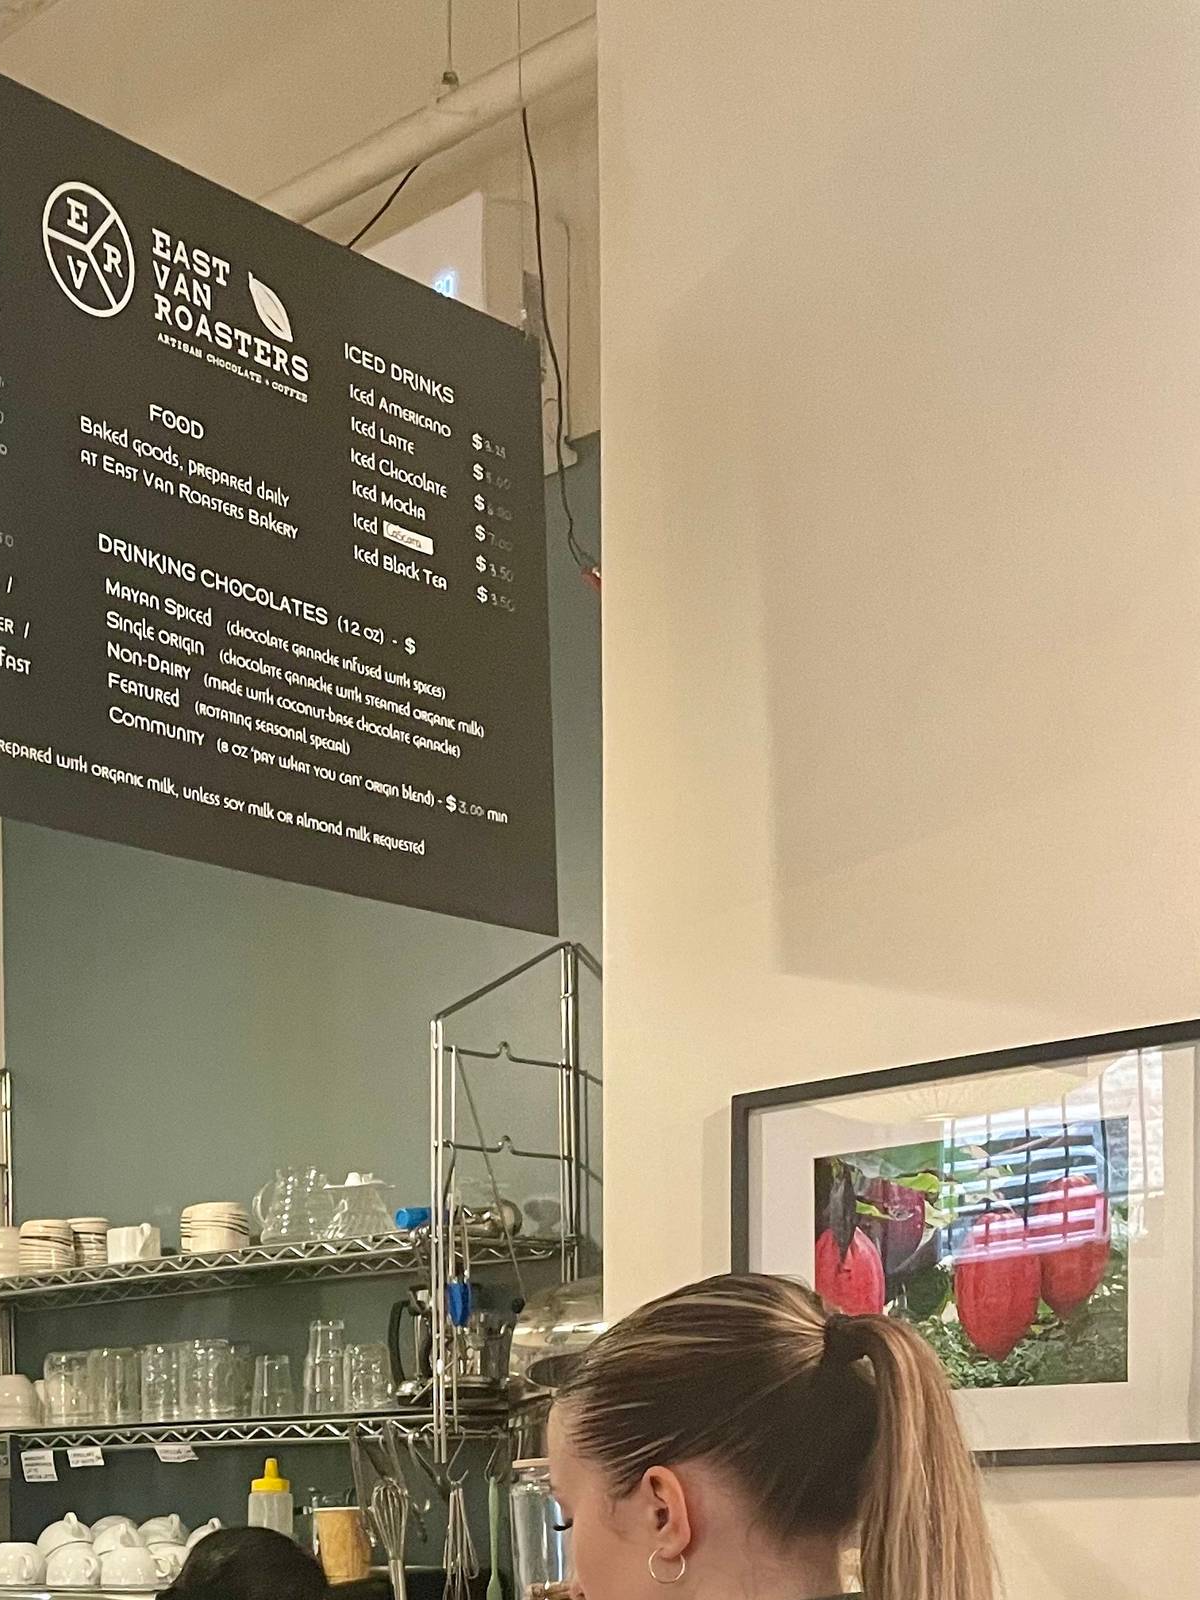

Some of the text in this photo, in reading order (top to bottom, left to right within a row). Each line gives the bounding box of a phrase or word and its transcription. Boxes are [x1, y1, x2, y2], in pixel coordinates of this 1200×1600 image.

[151, 227, 231, 287] EAST
[152, 259, 212, 311] VAN
[153, 292, 310, 383] ROASTERS
[156, 332, 203, 360] ARTISAN
[206, 352, 263, 385] CHOCOLATE
[343, 342, 456, 405] ICED DRINKS
[148, 403, 205, 440] FOOD
[350, 383, 452, 438] Iced Americano
[351, 415, 416, 456] Iced Latte
[79, 414, 291, 509] Baked goods, prepared daily
[350, 446, 376, 471] Iced
[378, 459, 448, 499] Chocolate
[102, 454, 139, 483] East
[142, 469, 174, 497] Van
[178, 483, 245, 521] Roasters
[248, 507, 299, 541] Bakery
[352, 479, 426, 522] Iced Mocha
[353, 512, 378, 536] Iced
[97, 531, 197, 583] DRINKING
[199, 568, 329, 627] CHOCOLATES
[337, 614, 362, 638] (12
[353, 544, 448, 591] Iced Black Tea
[104, 576, 447, 701] Mayan Spiced (chocolate ganache infused with spices)
[106, 610, 156, 642] Single
[219, 647, 283, 681] (chocolate
[284, 668, 333, 695] ganache
[335, 685, 362, 704] with
[364, 691, 411, 718] steamed
[412, 707, 457, 732] organic
[457, 719, 486, 740] milk)
[106, 640, 462, 759] Non-Dairy (made with coconut-base chocolate ganache)
[107, 671, 181, 708] Featured
[194, 699, 253, 732] (rotating
[254, 717, 308, 745] seasonal
[108, 705, 206, 747] Community
[277, 754, 312, 775] what
[312, 765, 337, 782] you
[401, 783, 435, 808] blend)
[486, 808, 509, 824] min
[56, 754, 88, 774] with
[90, 763, 145, 789] organic
[146, 776, 179, 799] milk,
[182, 785, 221, 807] unless
[247, 801, 275, 820] milk
[296, 811, 343, 837] almond
[345, 824, 373, 844] milk
[372, 832, 426, 856] requested
